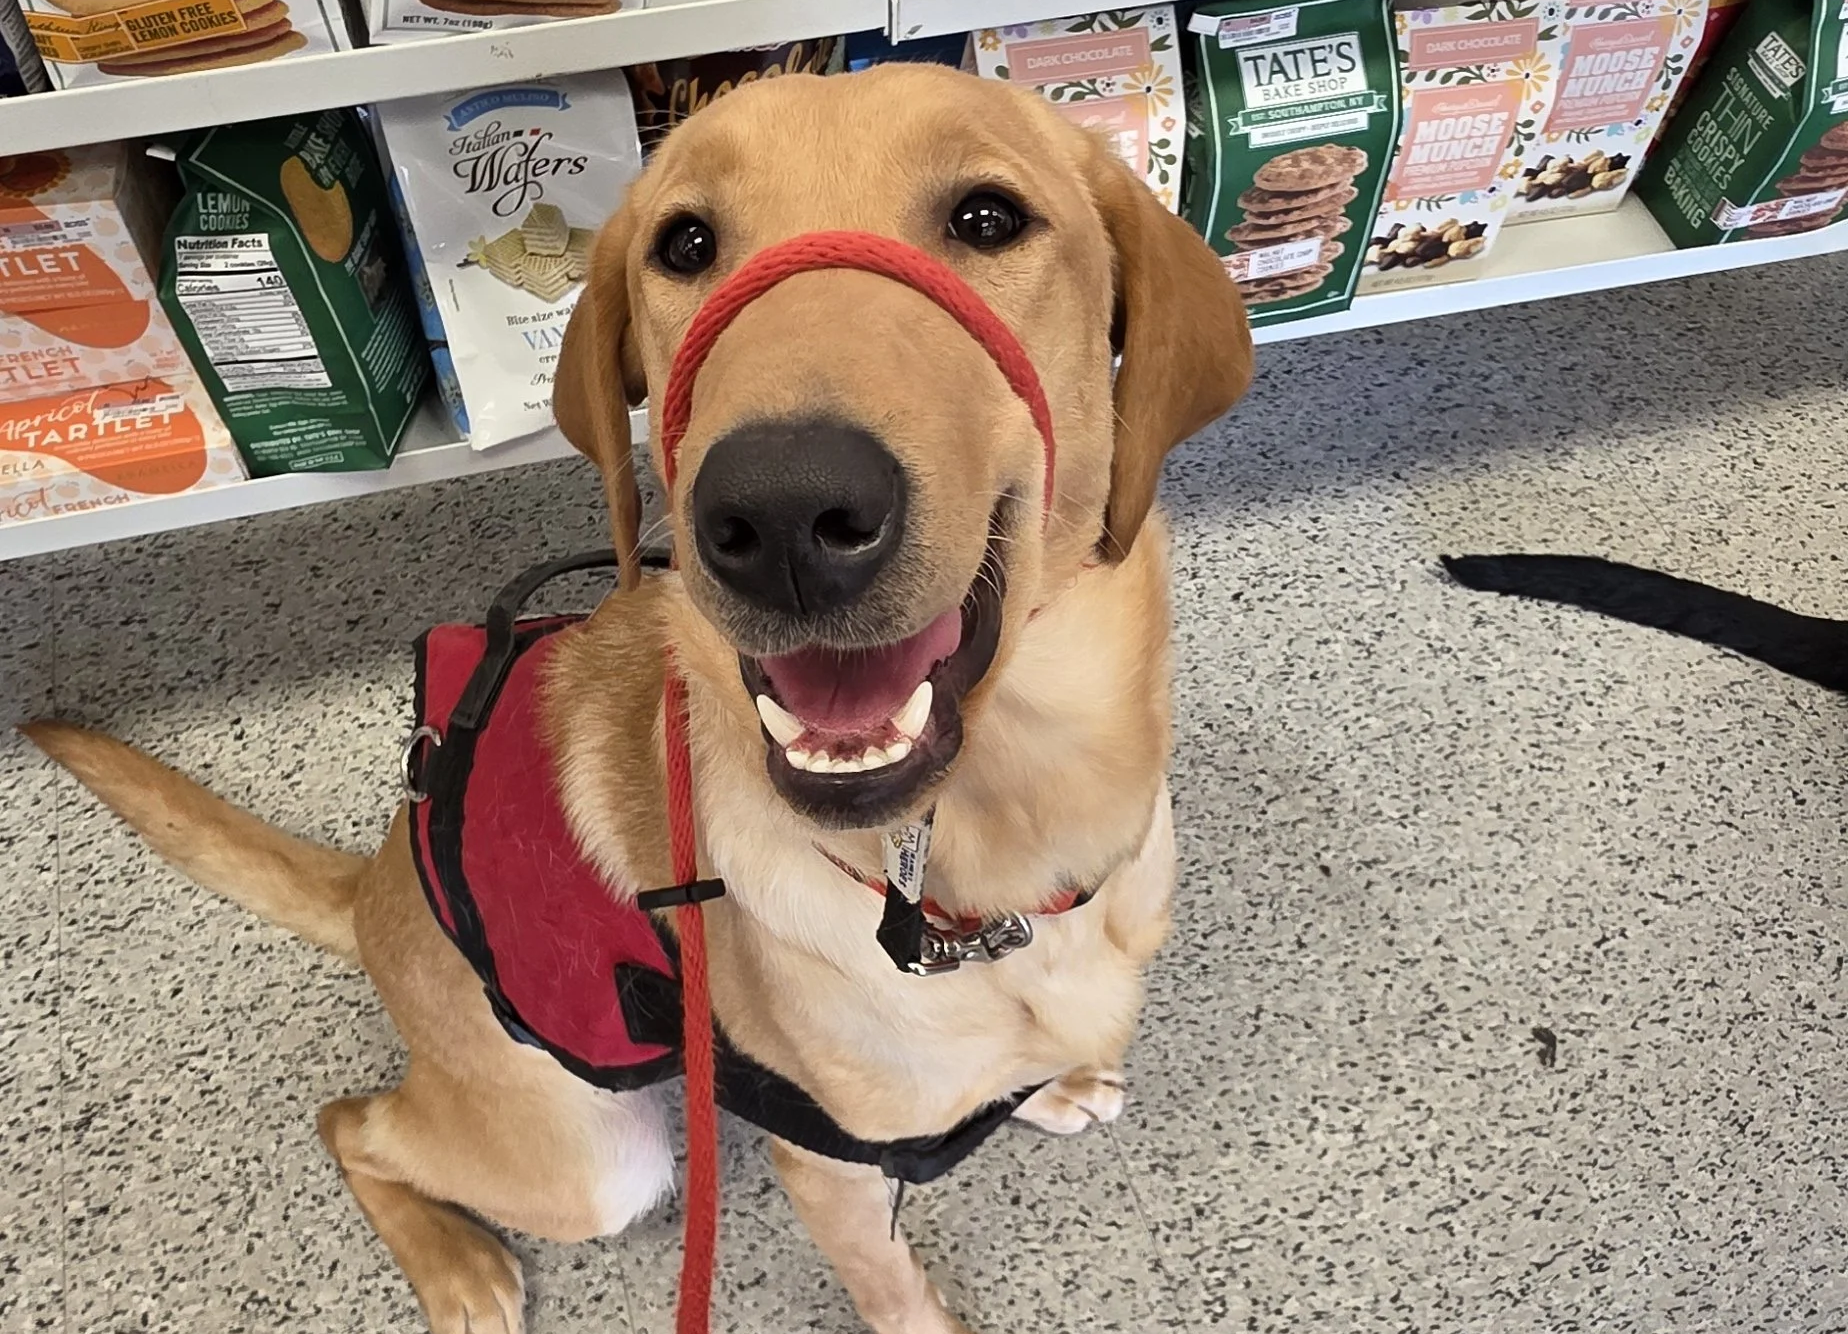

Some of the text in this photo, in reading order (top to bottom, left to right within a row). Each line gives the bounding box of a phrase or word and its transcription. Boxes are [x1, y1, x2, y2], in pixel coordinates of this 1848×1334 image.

[126, 1, 213, 32] GLUTEN FREE
[131, 10, 239, 44] LEMON COOKIES
[402, 14, 421, 24] NET
[1027, 45, 1134, 69] DARK CHOCOLATE
[1426, 33, 1523, 55] DARK CHOCOLATE
[1764, 34, 1806, 79] TATE'S
[1244, 41, 1357, 88] TATE'S
[1570, 46, 1661, 78] MOOSE
[1262, 77, 1348, 102] BAKE SHOP
[1562, 69, 1652, 99] MUNCH
[1726, 67, 1775, 131] SIGNATURE
[1413, 112, 1509, 144] MOOSE
[1711, 81, 1762, 156] THIN
[449, 120, 511, 156] Italian
[1406, 135, 1503, 166] MUNCH
[1695, 110, 1745, 175] CRISPY
[1686, 127, 1732, 190] COOKIES
[452, 131, 589, 218] Wafers
[197, 192, 251, 213] LEMON
[1663, 165, 1706, 230] BAKING
[200, 213, 250, 231] COOKIES
[177, 237, 264, 250] Nutrition Facts
[0, 252, 81, 277] TLET
[177, 282, 221, 293] Calories
[256, 275, 284, 288] 140
[506, 310, 554, 327] Bite size
[23, 412, 172, 448] TARTLET
[52, 493, 130, 515] FRENCH
